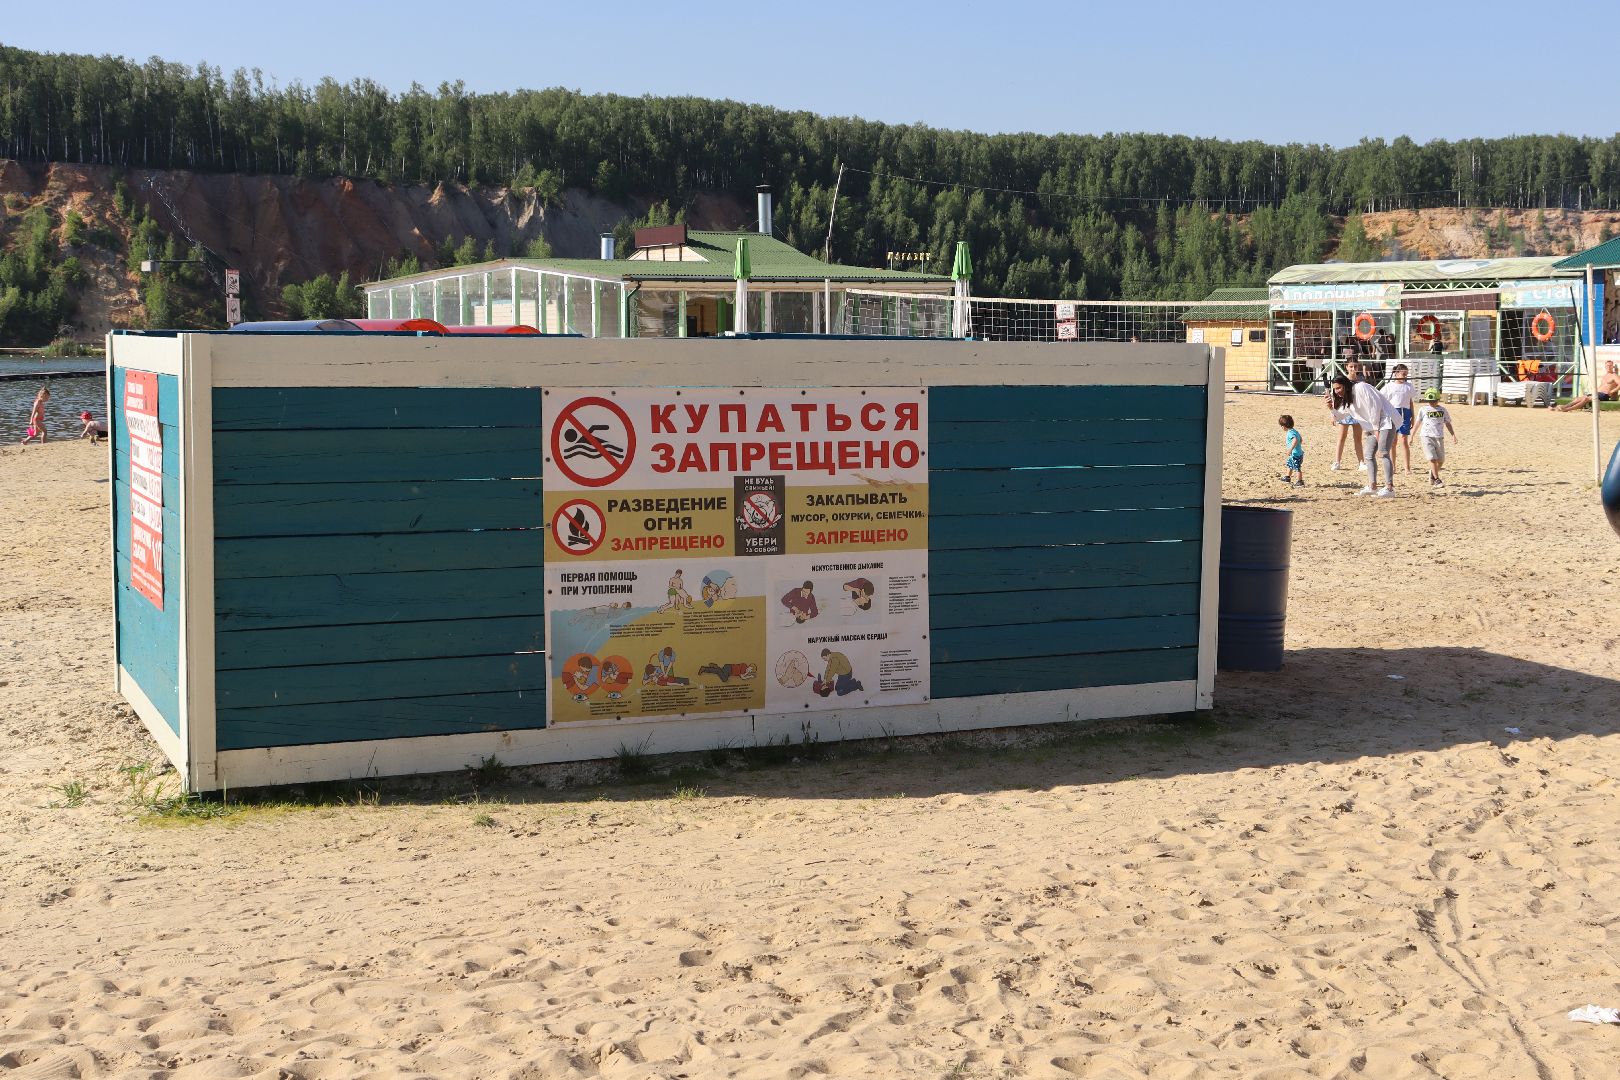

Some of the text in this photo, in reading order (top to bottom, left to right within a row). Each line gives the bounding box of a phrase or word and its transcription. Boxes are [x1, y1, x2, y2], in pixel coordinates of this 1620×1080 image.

[650, 403, 919, 434] КУПАТЬСЯ
[650, 439, 920, 476] ЗАПРЕЩЕНО
[607, 496, 727, 513] РАЗВЕДЕНИЕ
[805, 492, 908, 507] ЗАКАПЫВАТЬ
[643, 517, 693, 531] ОГНЯ
[790, 513, 829, 523] МУСОР,
[831, 512, 873, 522] ОКУРКИ,
[610, 535, 725, 552] ЗАПРЕЩЕНО
[746, 537, 777, 546] УБЕРИ
[805, 529, 909, 545] ЗАПРЕЩЕНО
[811, 563, 857, 572] ИСКУССТВЕННОЕ
[560, 571, 638, 582] ПЕРВАЯ ПОМОЩЬ
[560, 584, 633, 596] ПРИ УТОПЛЕНИИ
[807, 634, 840, 644] НАРУЖНЫЙ
[866, 633, 888, 641] СЕРДЦА
